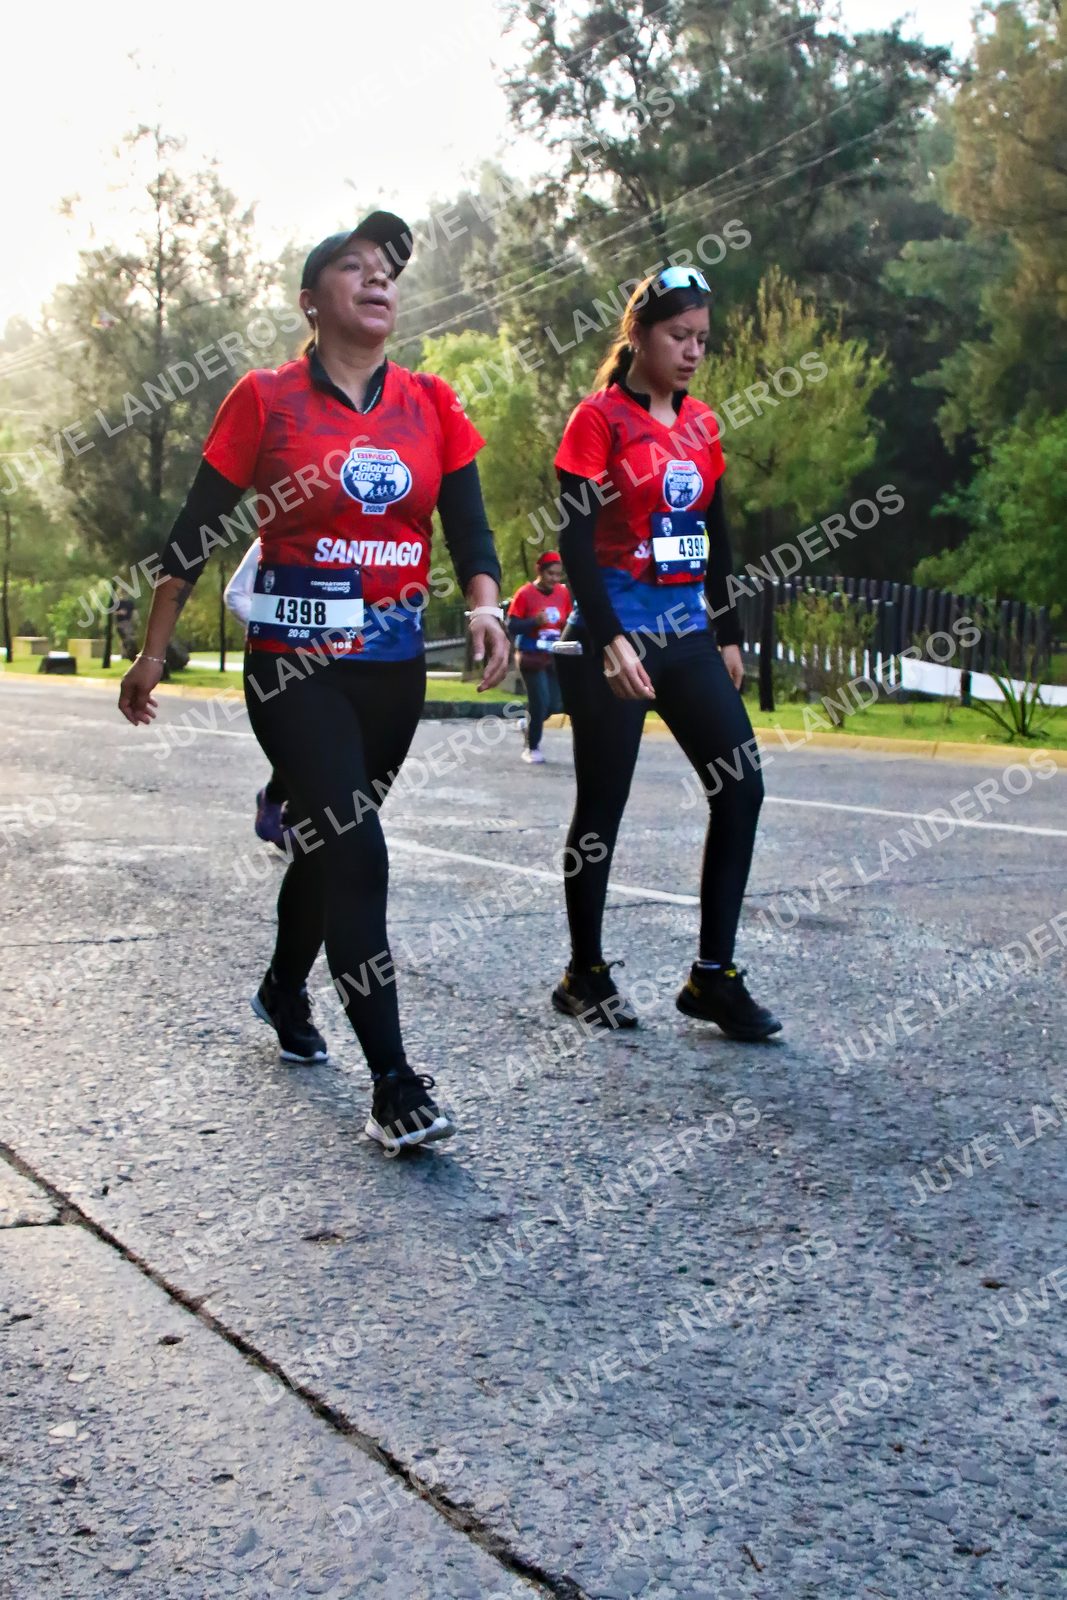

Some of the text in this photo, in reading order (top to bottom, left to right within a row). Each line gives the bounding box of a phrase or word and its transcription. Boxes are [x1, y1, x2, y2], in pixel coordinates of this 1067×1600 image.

[357, 453, 393, 463] BIMBO
[357, 462, 393, 474] Global
[351, 470, 382, 482] Race
[314, 538, 423, 567] SANTIAGO
[275, 598, 326, 626] 4398
[332, 641, 352, 649] 10K
